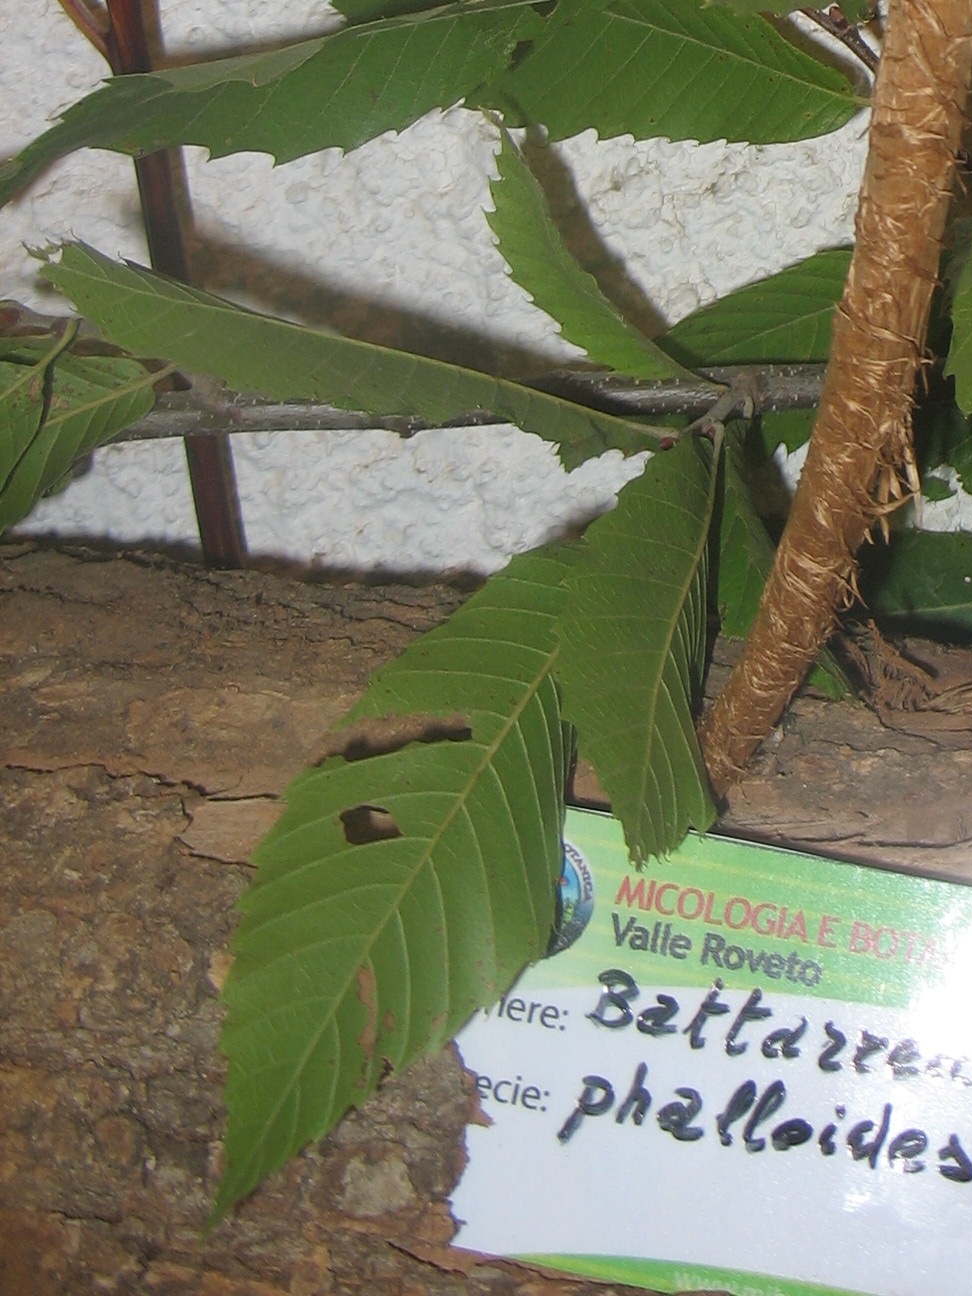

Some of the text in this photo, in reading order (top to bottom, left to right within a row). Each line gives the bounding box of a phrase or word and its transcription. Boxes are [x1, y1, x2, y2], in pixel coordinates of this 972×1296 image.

[563, 843, 593, 901] OTANICA
[611, 911, 823, 987] Valle Roveto
[613, 875, 957, 968] MICOLOGIA E BOTA
[475, 1075, 551, 1112] ecie:
